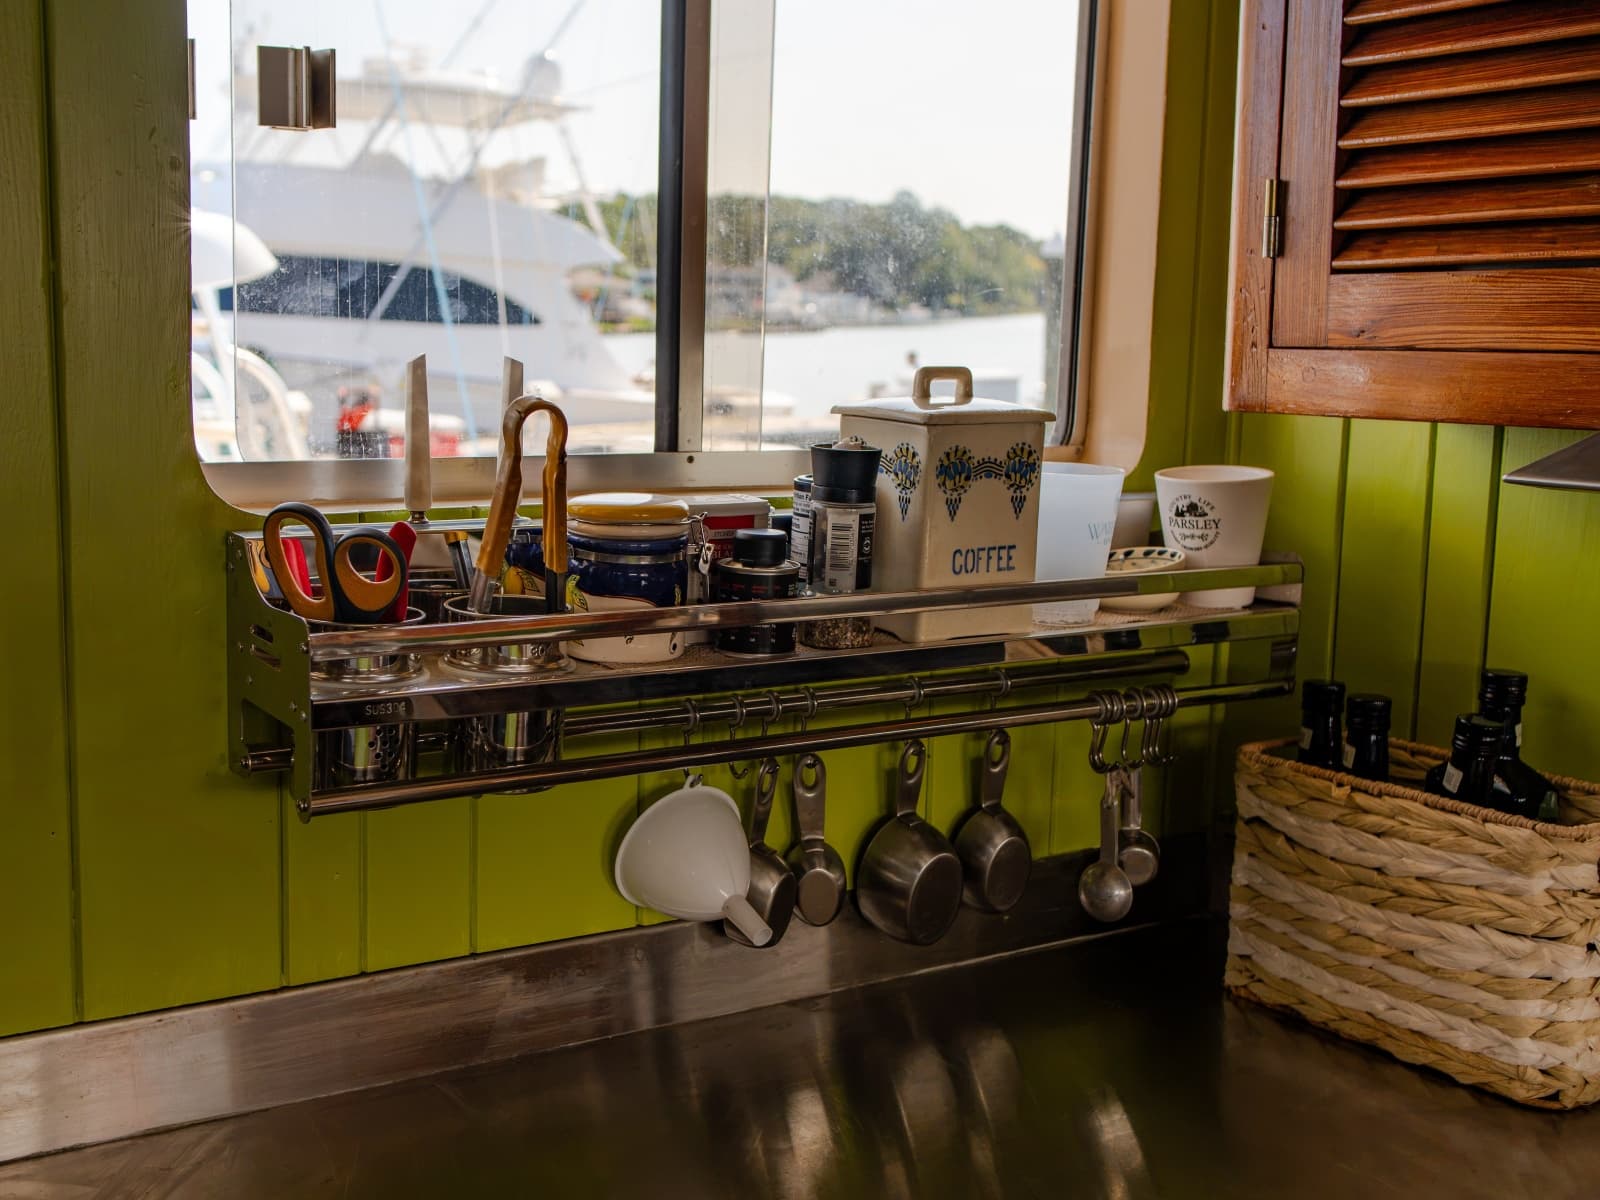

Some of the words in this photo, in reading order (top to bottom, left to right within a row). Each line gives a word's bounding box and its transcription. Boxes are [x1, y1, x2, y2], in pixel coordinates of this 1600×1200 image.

[1169, 494, 1192, 512] NTRY
[1169, 517, 1221, 530] PARSLEY
[952, 544, 1017, 575] COFFEE
